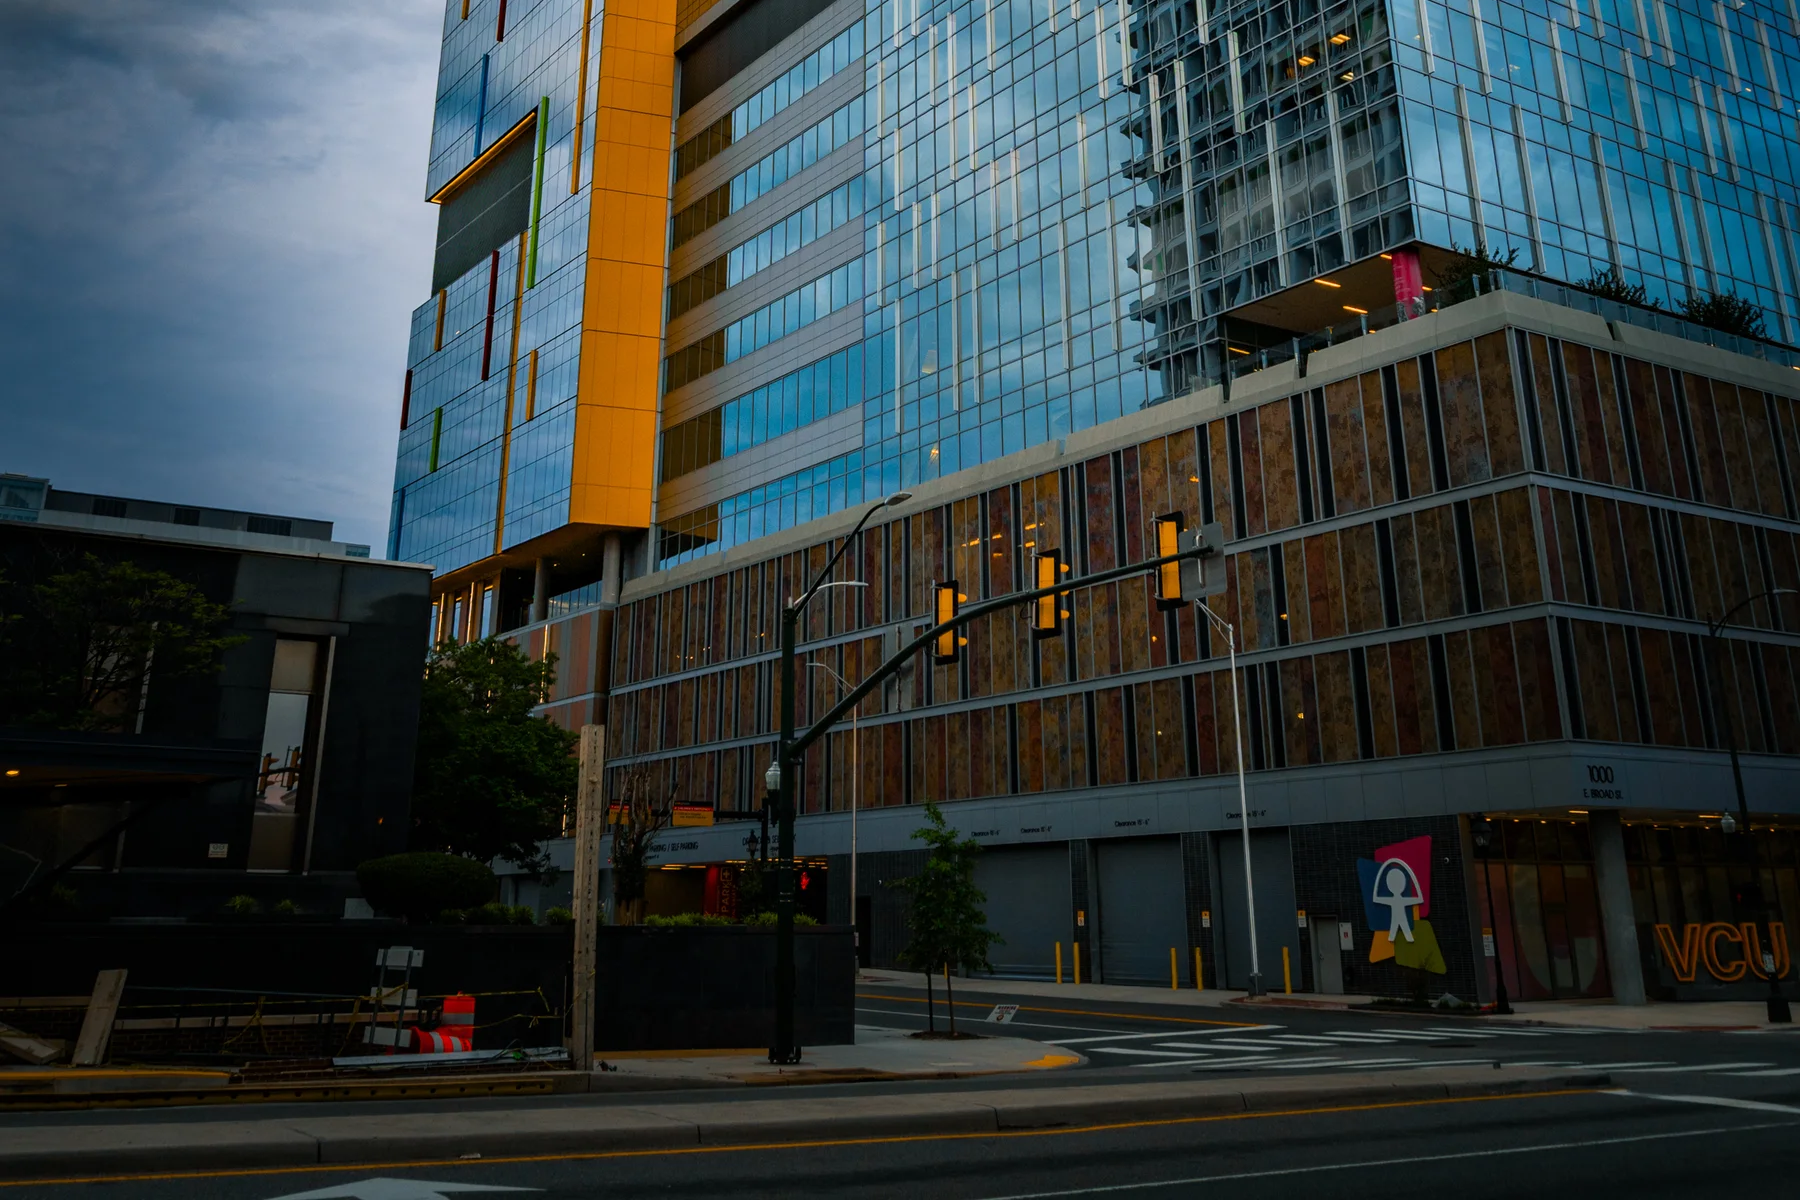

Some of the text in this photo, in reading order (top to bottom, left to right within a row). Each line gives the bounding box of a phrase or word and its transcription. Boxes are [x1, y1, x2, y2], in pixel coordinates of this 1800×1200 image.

[1587, 765, 1614, 784] 1000
[1590, 789, 1615, 799] BROAD
[680, 841, 699, 850] PARKING
[721, 882, 730, 912] PARK
[1654, 921, 1791, 983] VCU
